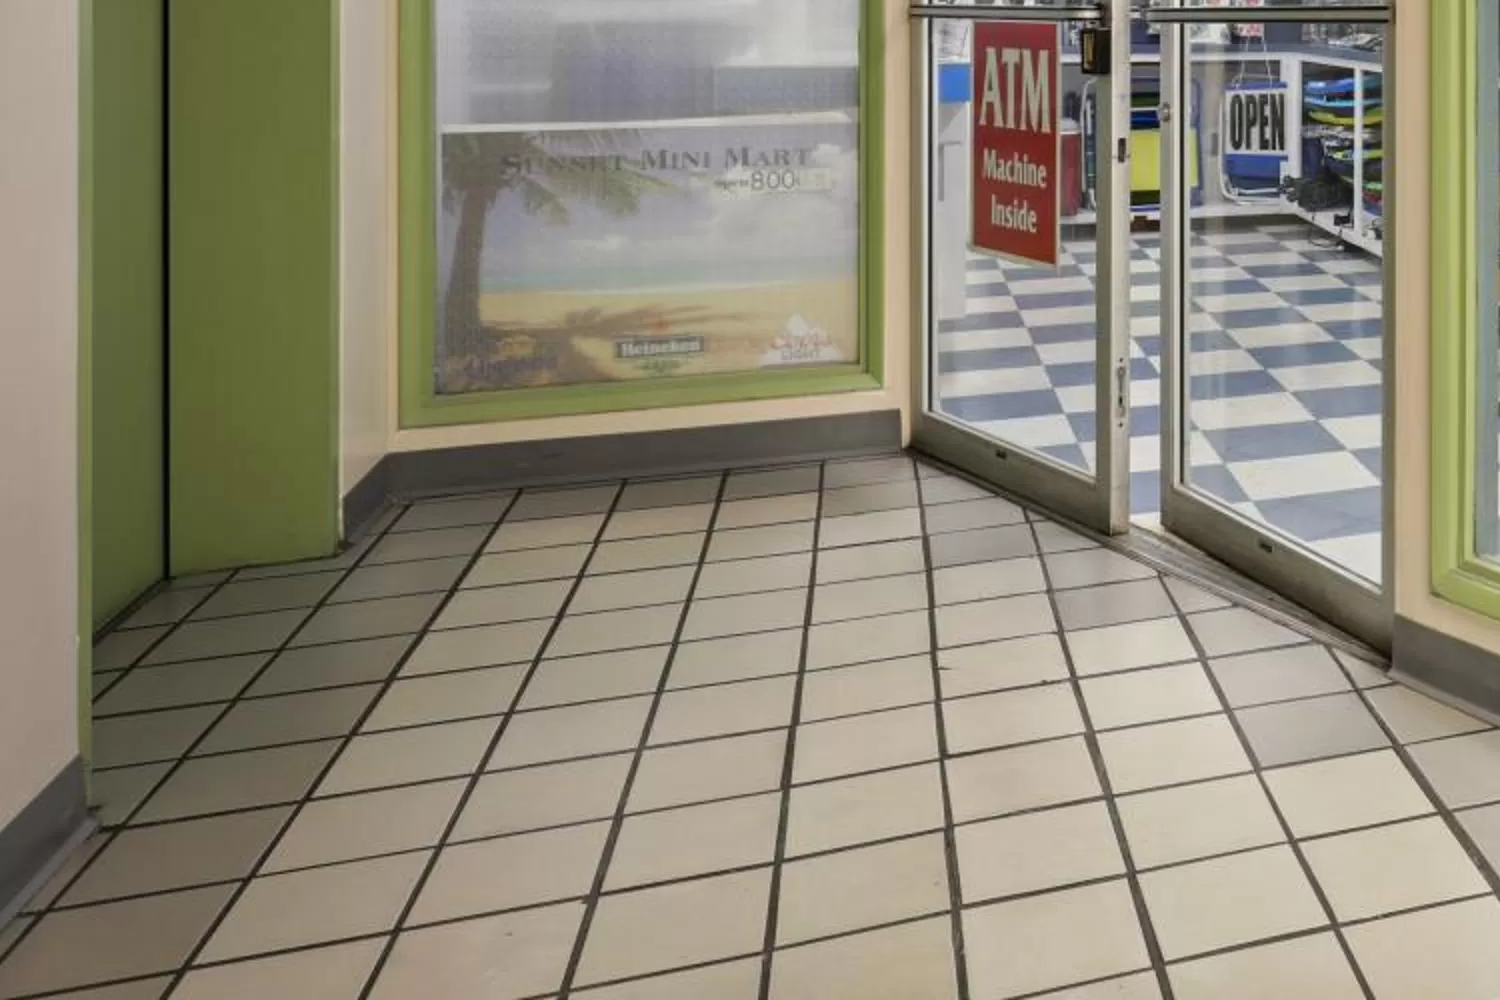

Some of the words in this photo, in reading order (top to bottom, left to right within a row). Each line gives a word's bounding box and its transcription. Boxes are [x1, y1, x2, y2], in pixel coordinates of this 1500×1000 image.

[979, 46, 1051, 134] ATM
[1230, 93, 1284, 151] OPEN
[983, 147, 1047, 188] Machine
[990, 193, 1037, 234] Inside
